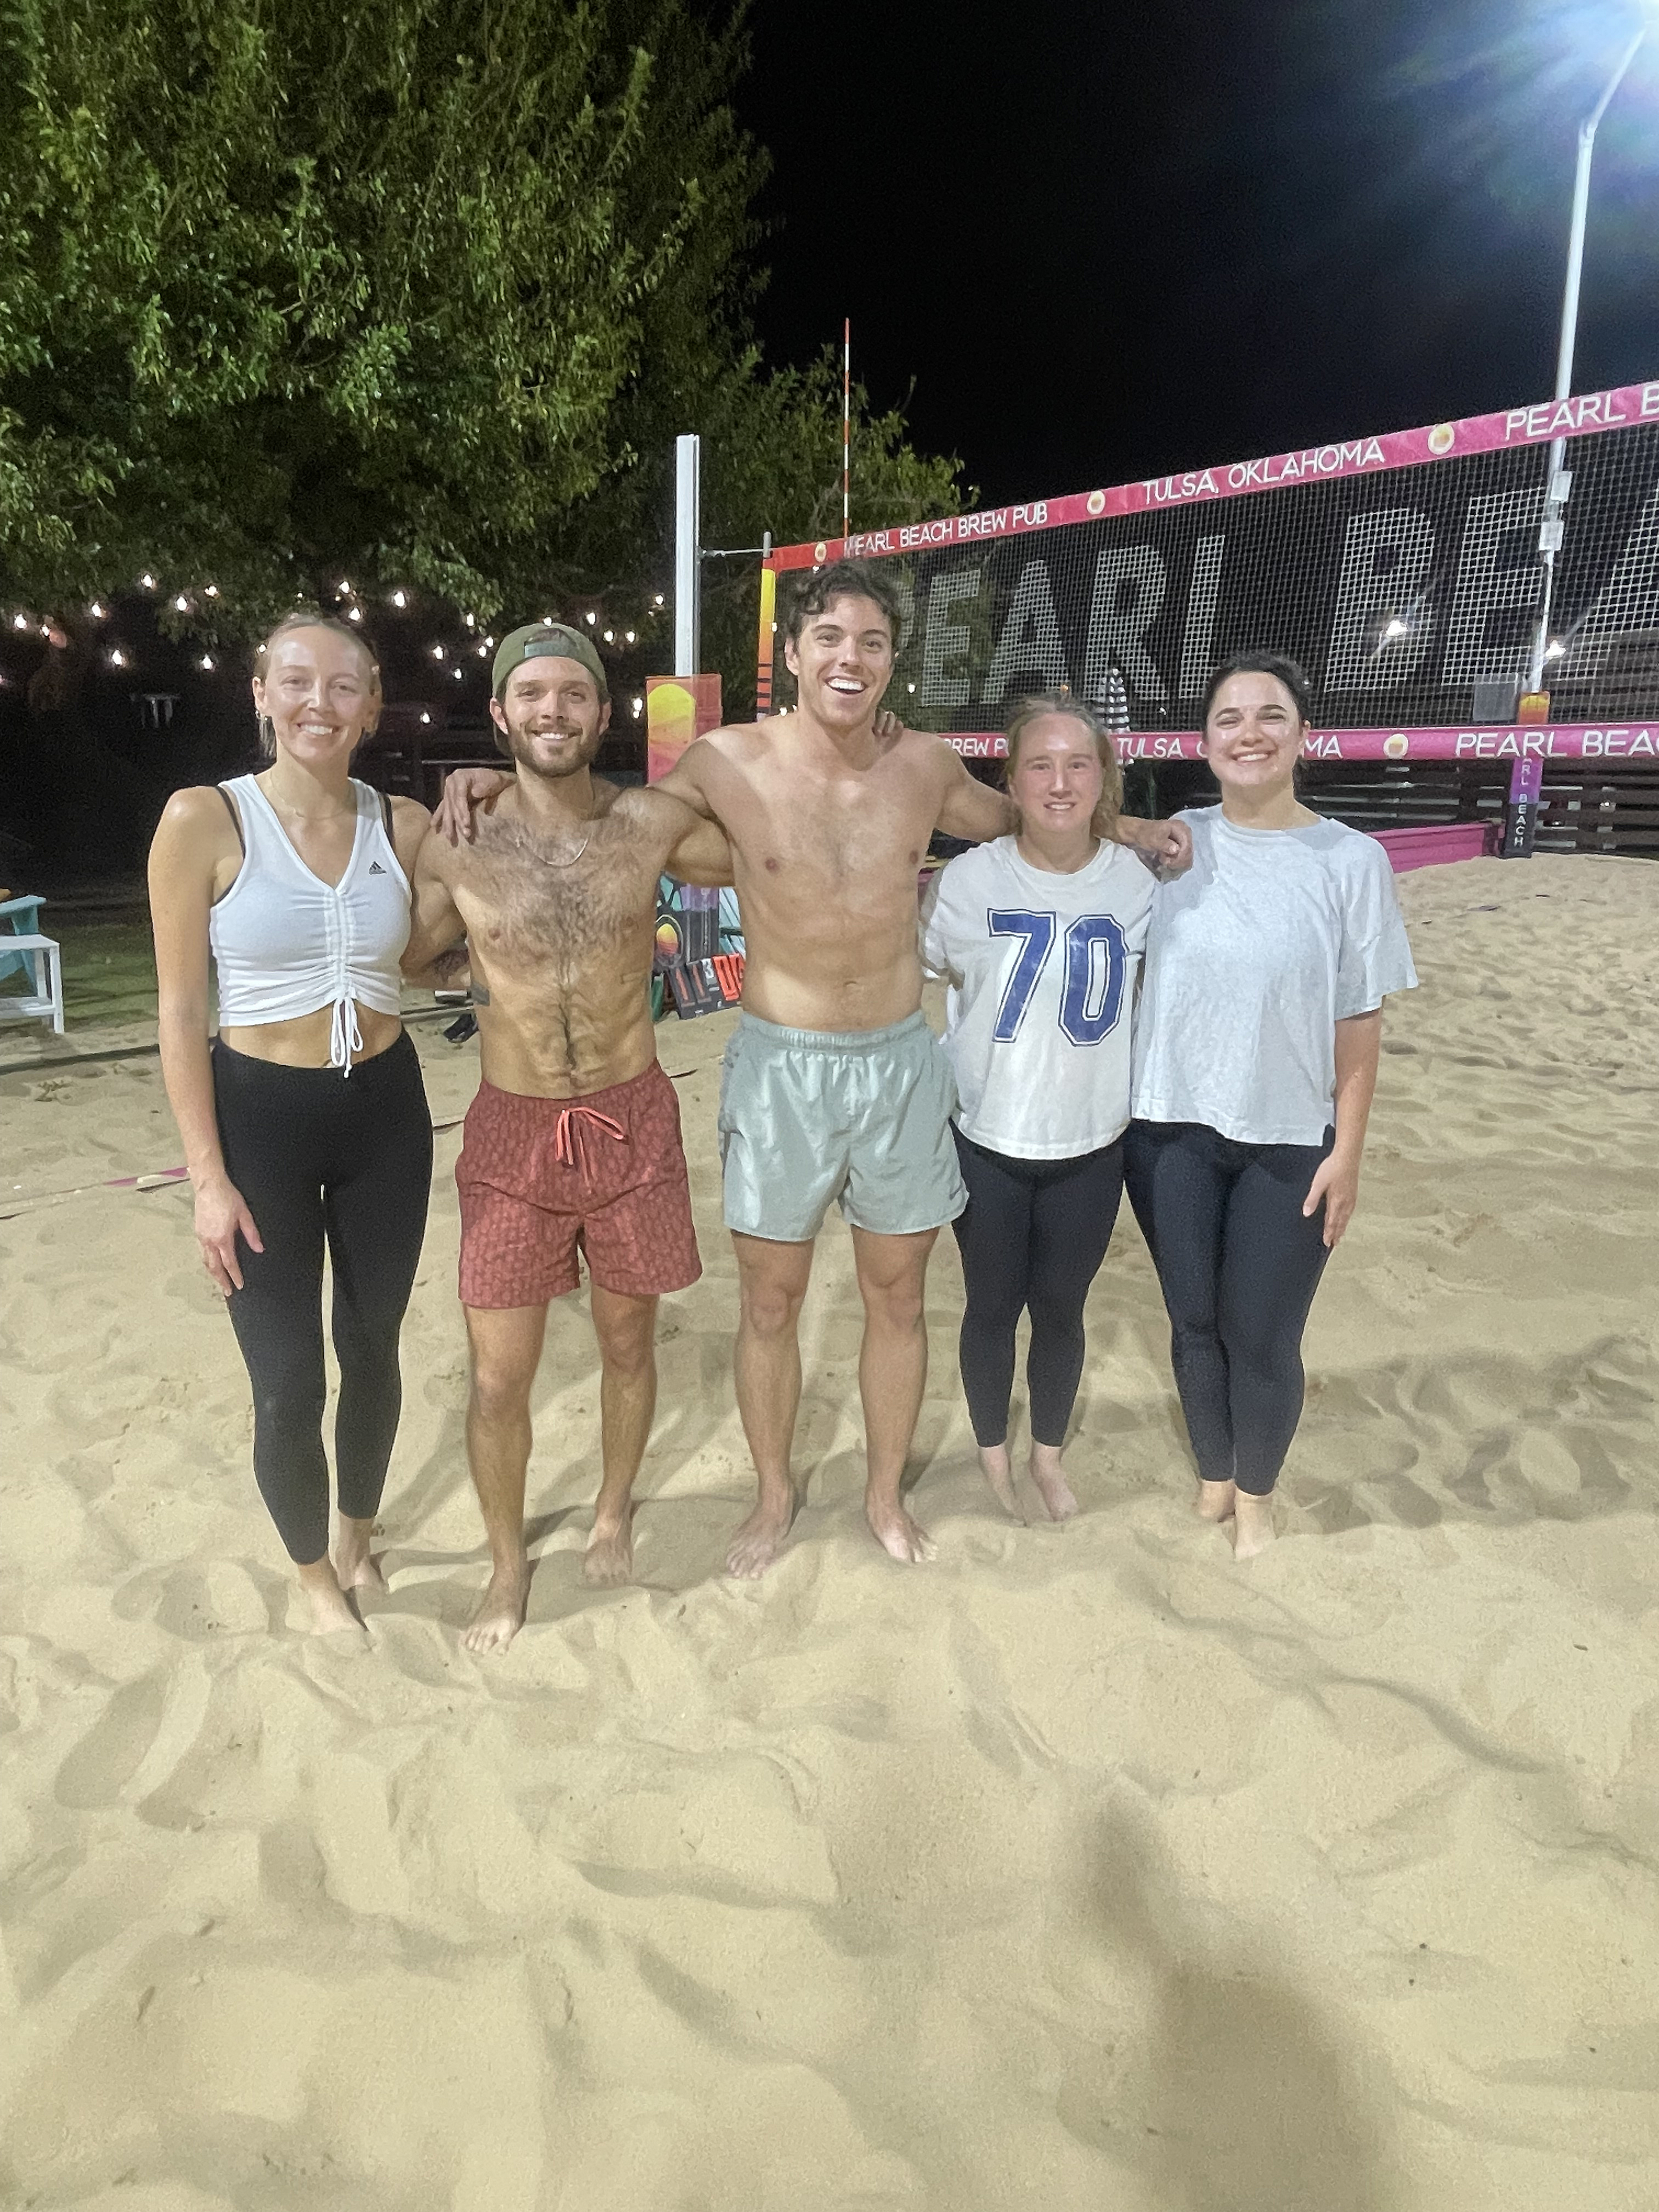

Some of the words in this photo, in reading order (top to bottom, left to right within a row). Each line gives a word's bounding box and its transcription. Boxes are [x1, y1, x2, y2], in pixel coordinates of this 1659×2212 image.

[1506, 393, 1626, 441] PEARL
[1143, 469, 1219, 505] TULSA,
[1228, 438, 1385, 488] OKLAHOMA
[900, 521, 953, 548] BEACH
[958, 509, 1008, 538] BREW
[1013, 501, 1048, 528] PUB
[896, 534, 1225, 707] EARL
[1455, 731, 1567, 758] PEARL
[1581, 729, 1659, 758] BEA
[1513, 793, 1528, 847] BEACH
[987, 907, 1130, 1047] 70
